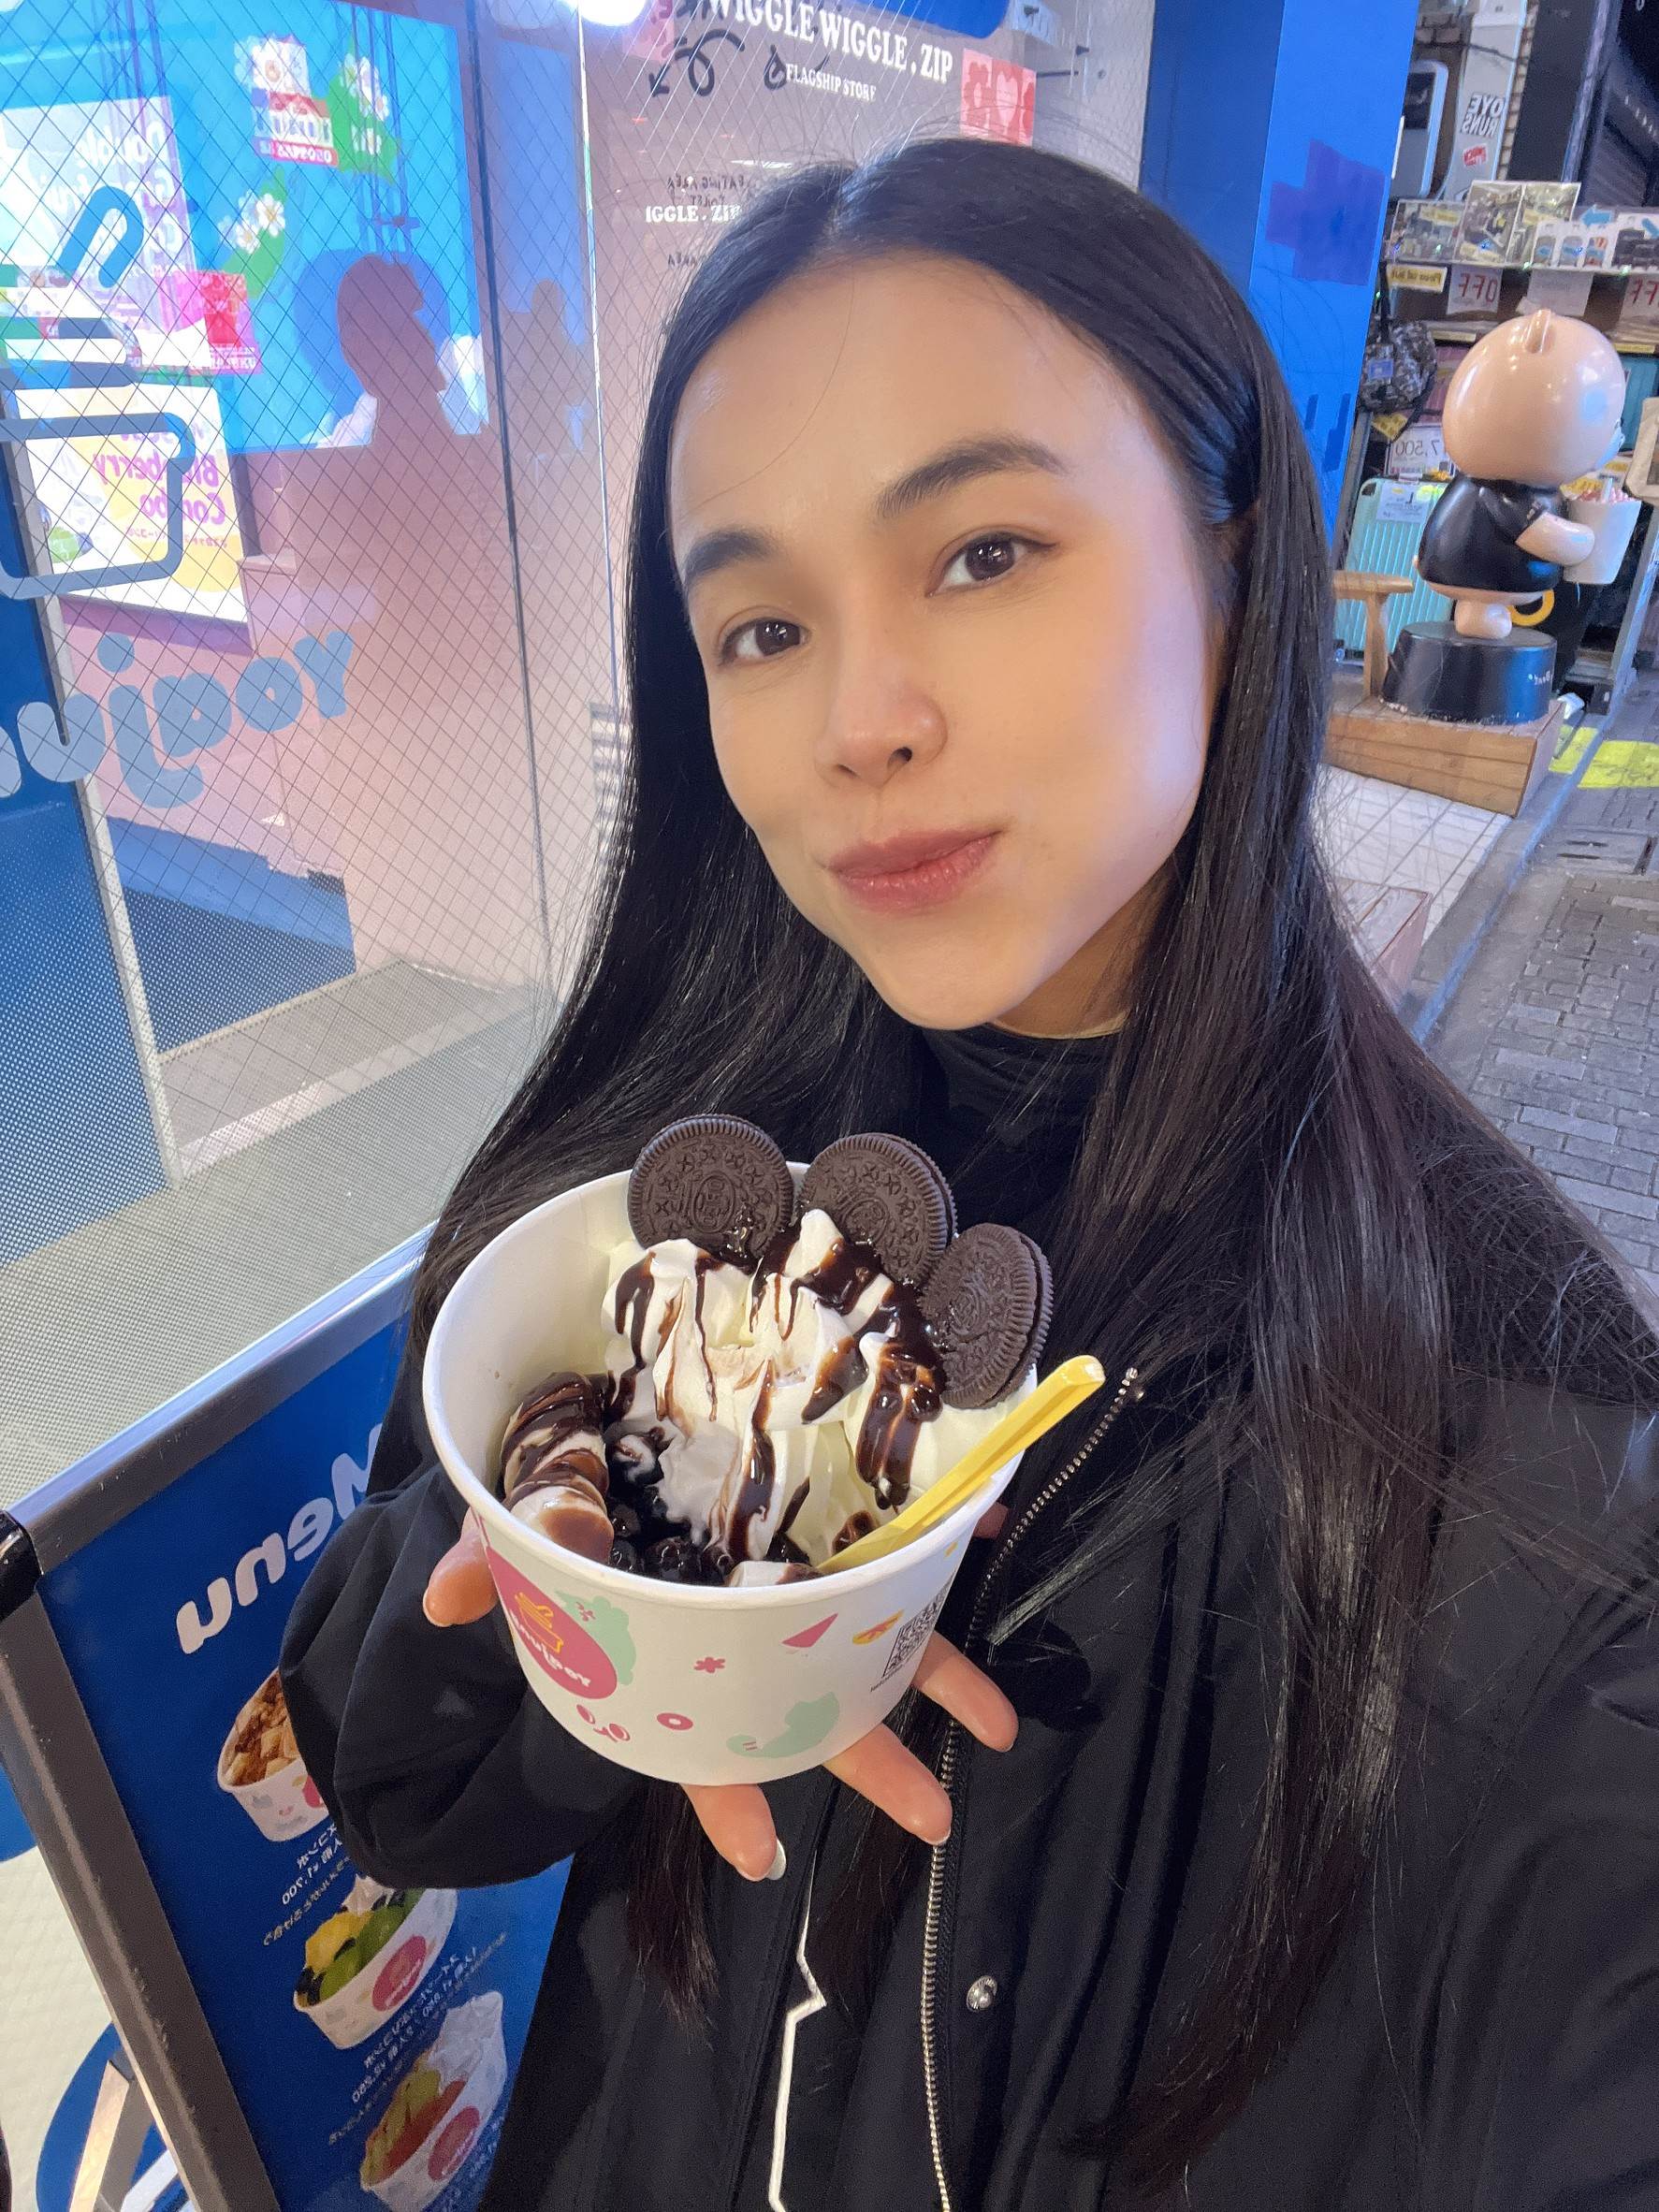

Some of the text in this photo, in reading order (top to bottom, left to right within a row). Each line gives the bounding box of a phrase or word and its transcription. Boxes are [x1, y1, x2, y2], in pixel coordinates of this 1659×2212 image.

[708, 0, 816, 43] WIGGLE
[819, 11, 910, 70] WIGGLE
[784, 63, 877, 103] FLAGSHIP STORE
